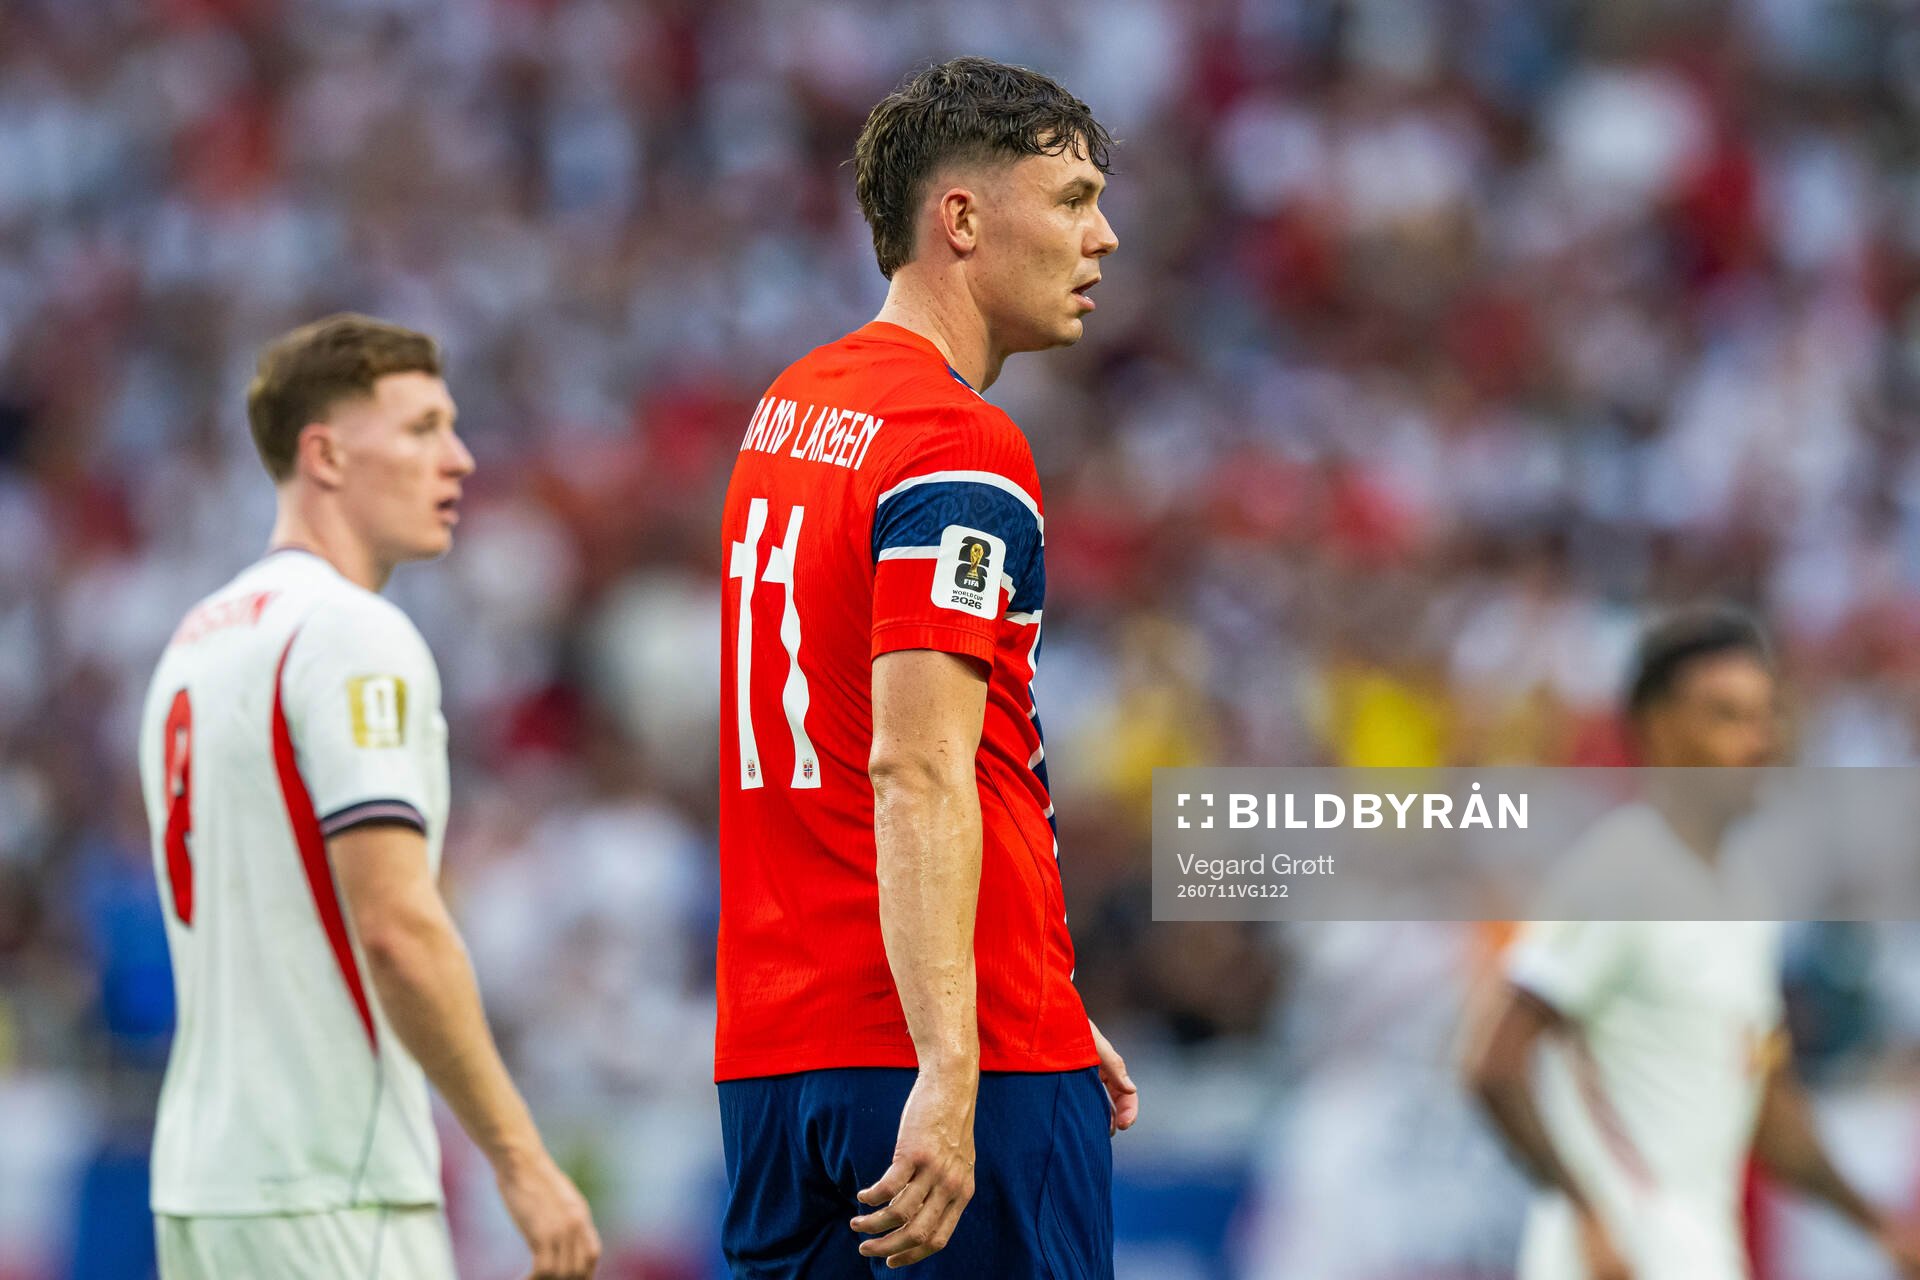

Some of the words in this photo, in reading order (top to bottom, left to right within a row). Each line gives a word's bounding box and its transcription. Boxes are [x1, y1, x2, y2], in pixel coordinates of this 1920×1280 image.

[789, 404, 885, 471] LARSEN
[964, 578, 979, 588] FIFA
[952, 590, 973, 598] WORLD
[951, 595, 982, 609] 2026
[729, 498, 821, 789] 11
